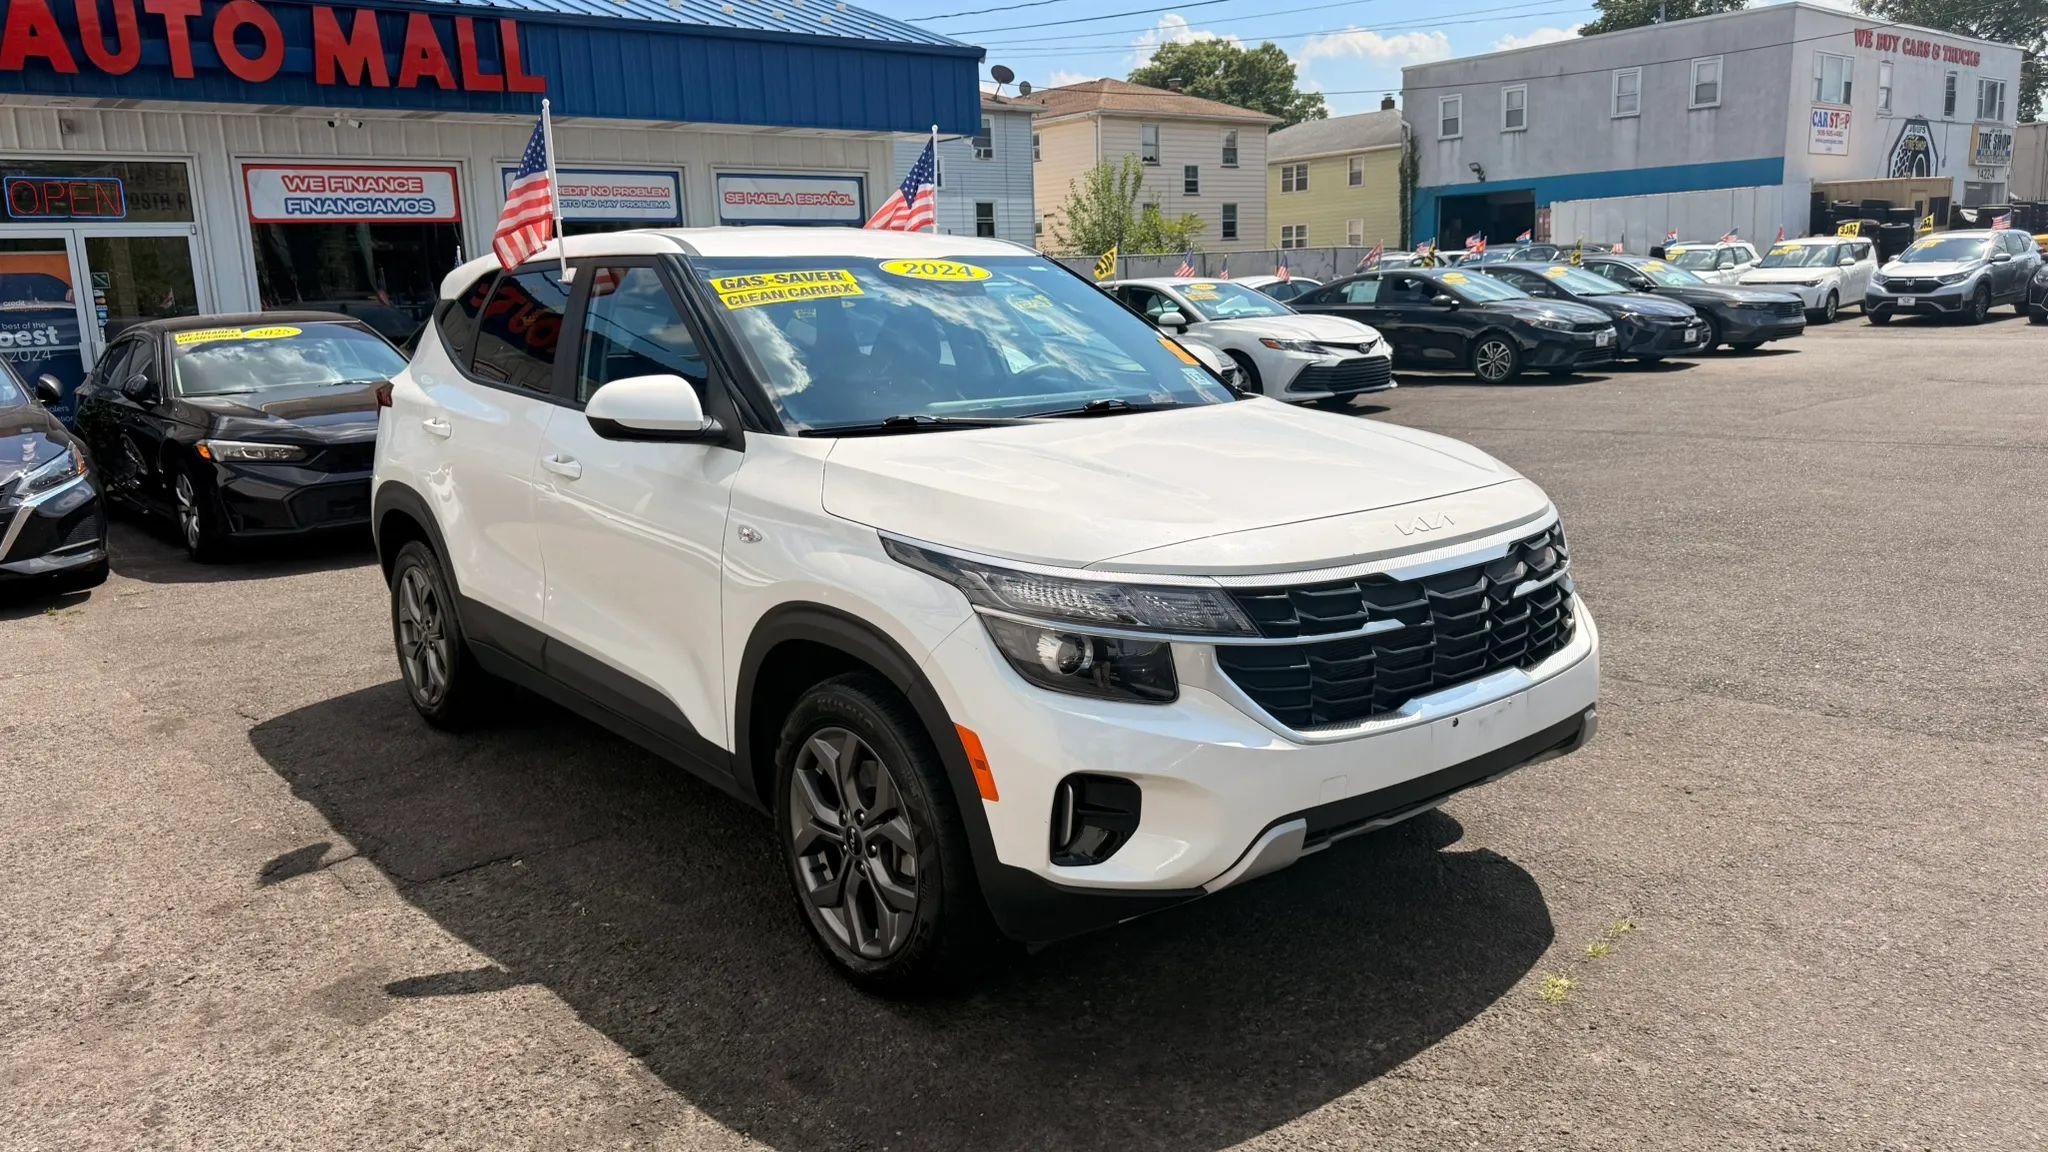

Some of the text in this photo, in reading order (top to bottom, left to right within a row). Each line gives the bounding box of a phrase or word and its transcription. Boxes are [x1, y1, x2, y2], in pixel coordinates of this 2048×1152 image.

[0, 0, 546, 93] AUTO MALL
[1855, 28, 1980, 67] WE BUY CARS & TRUCKS
[1812, 111, 1828, 128] CAR
[1978, 132, 2011, 150] TIRE SHOP
[283, 176, 422, 192] WE FINANCE
[558, 186, 671, 198] EDIT NO PROBLEM
[9, 180, 122, 216] OPEN
[286, 198, 434, 214] FINANCIAMOS
[559, 200, 671, 209] DITO NO HAY PROBLEMA
[725, 190, 855, 206] SE HABLA ESPAÑOL
[902, 262, 975, 277] 2024
[720, 271, 841, 290] GAS-SAVER
[727, 283, 854, 306] CLEAN CARFAX
[9, 350, 51, 362] 2024
